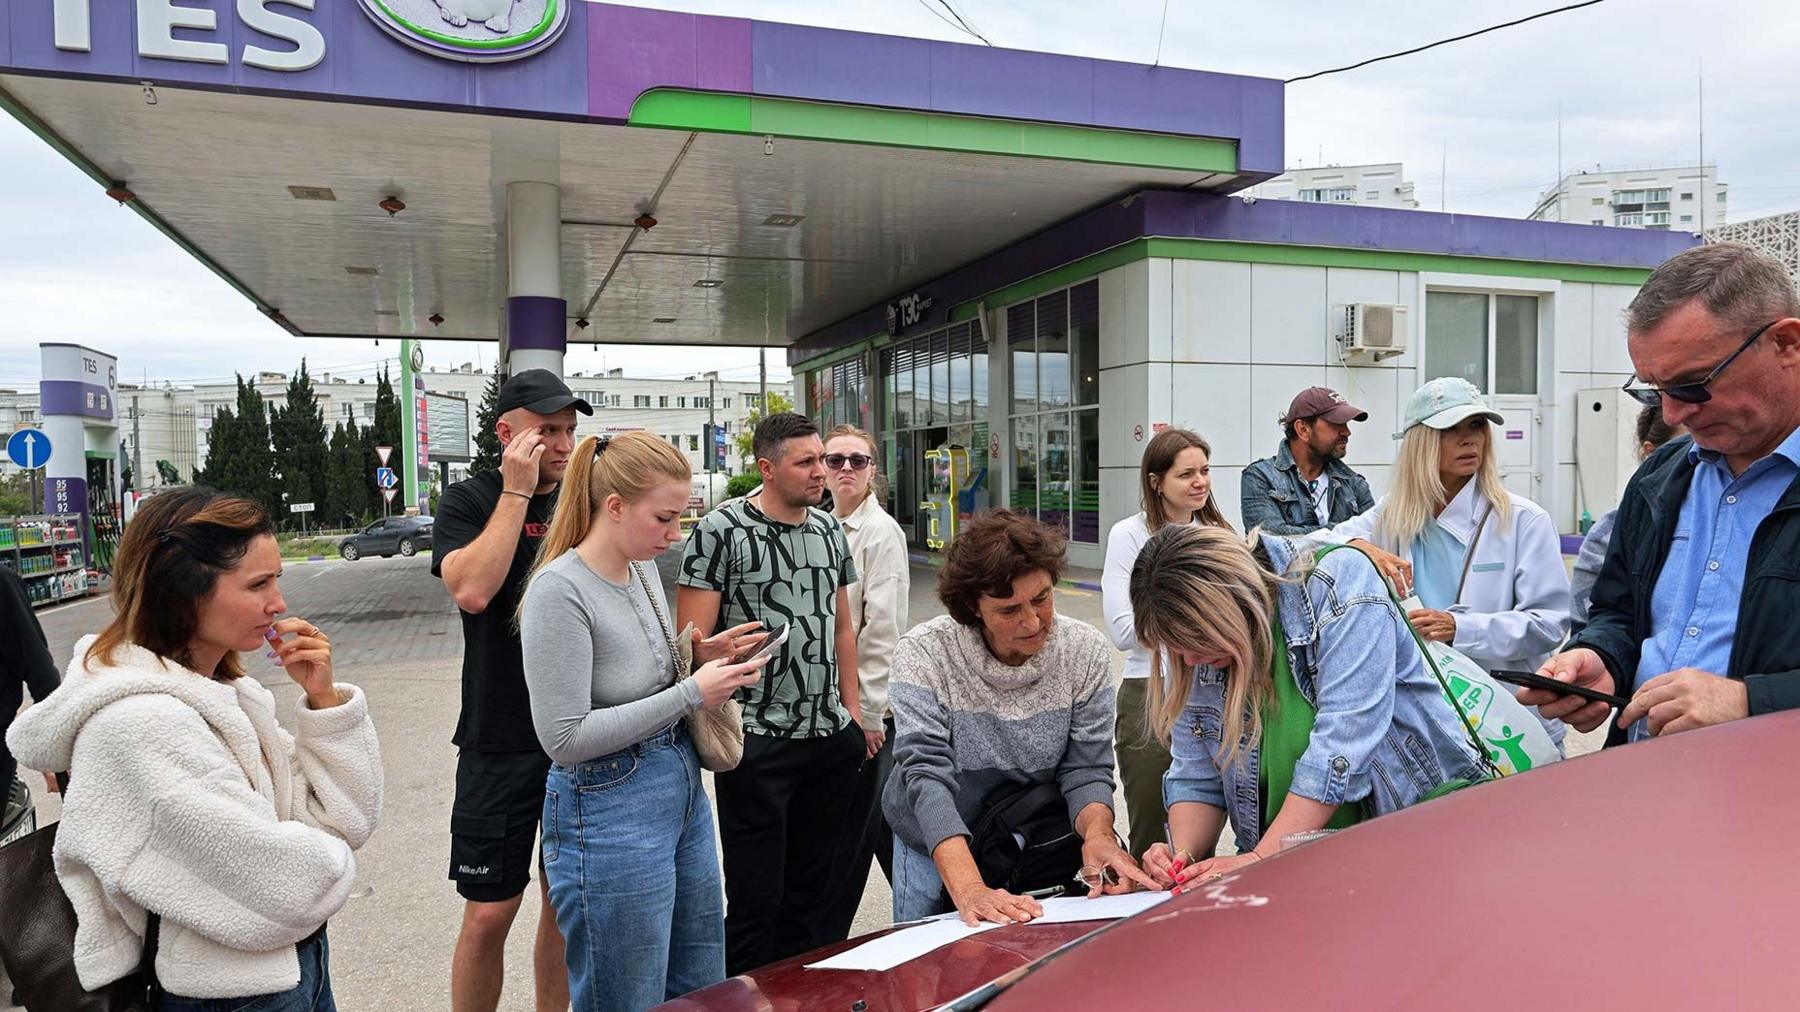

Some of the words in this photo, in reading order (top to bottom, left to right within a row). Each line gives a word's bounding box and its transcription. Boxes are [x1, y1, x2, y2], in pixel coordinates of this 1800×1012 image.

[83, 357, 97, 374] TES
[108, 365, 115, 390] 6
[56, 479, 67, 489] 95
[57, 492, 68, 502] 95
[57, 503, 68, 513] 92
